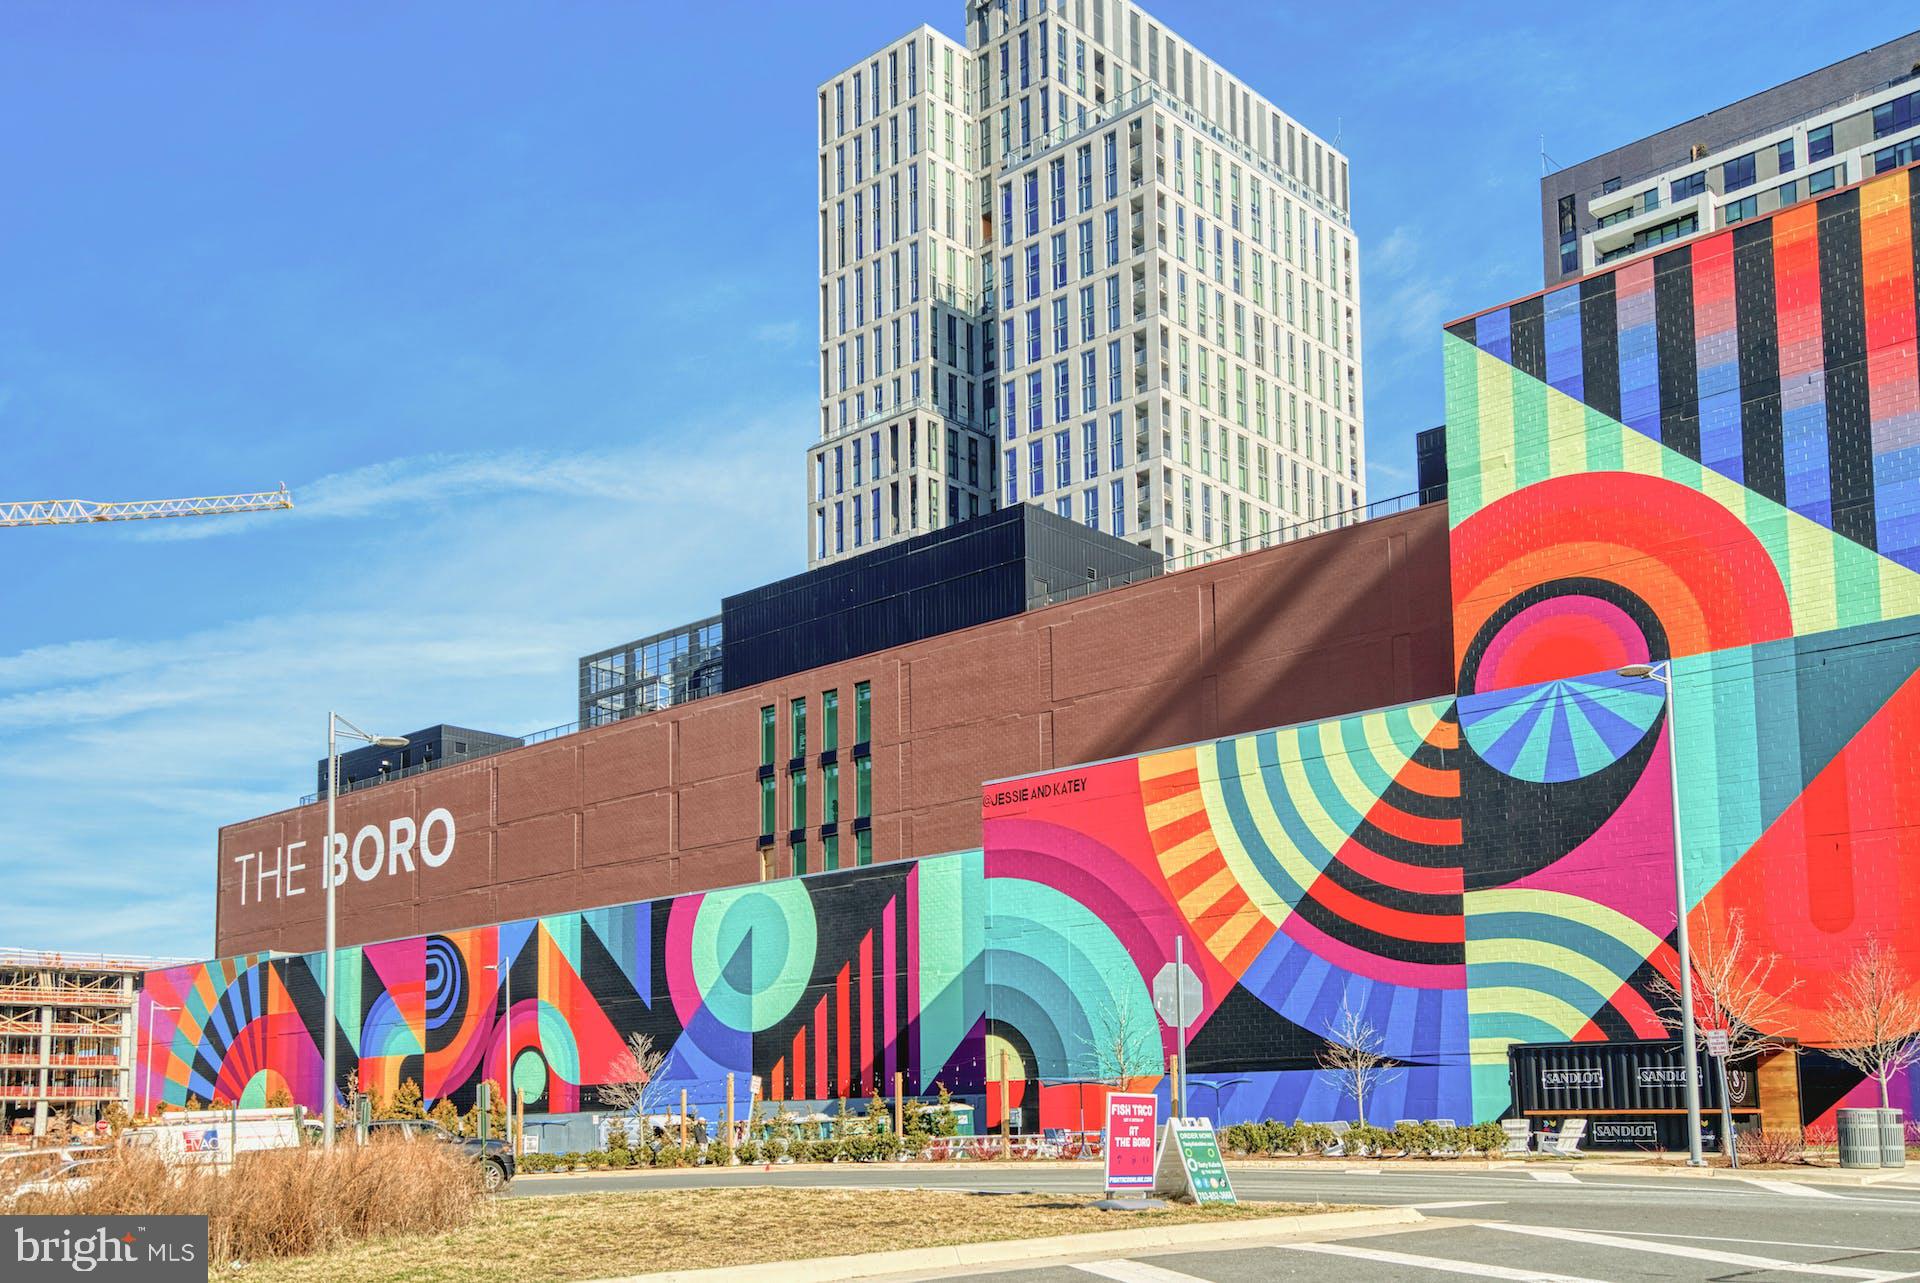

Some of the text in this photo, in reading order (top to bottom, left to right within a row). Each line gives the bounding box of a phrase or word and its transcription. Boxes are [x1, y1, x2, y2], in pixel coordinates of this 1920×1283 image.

[234, 807, 456, 906] THE BORO
[1546, 1071, 1600, 1084] SANDLOT
[1641, 1070, 1699, 1082] SANDLO
[1111, 1104, 1131, 1116] FISH
[1129, 1125, 1139, 1136] AT
[1597, 1125, 1653, 1137] SANDLOT
[183, 1137, 220, 1152] HVAC
[1114, 1137, 1150, 1148] THE BORO
